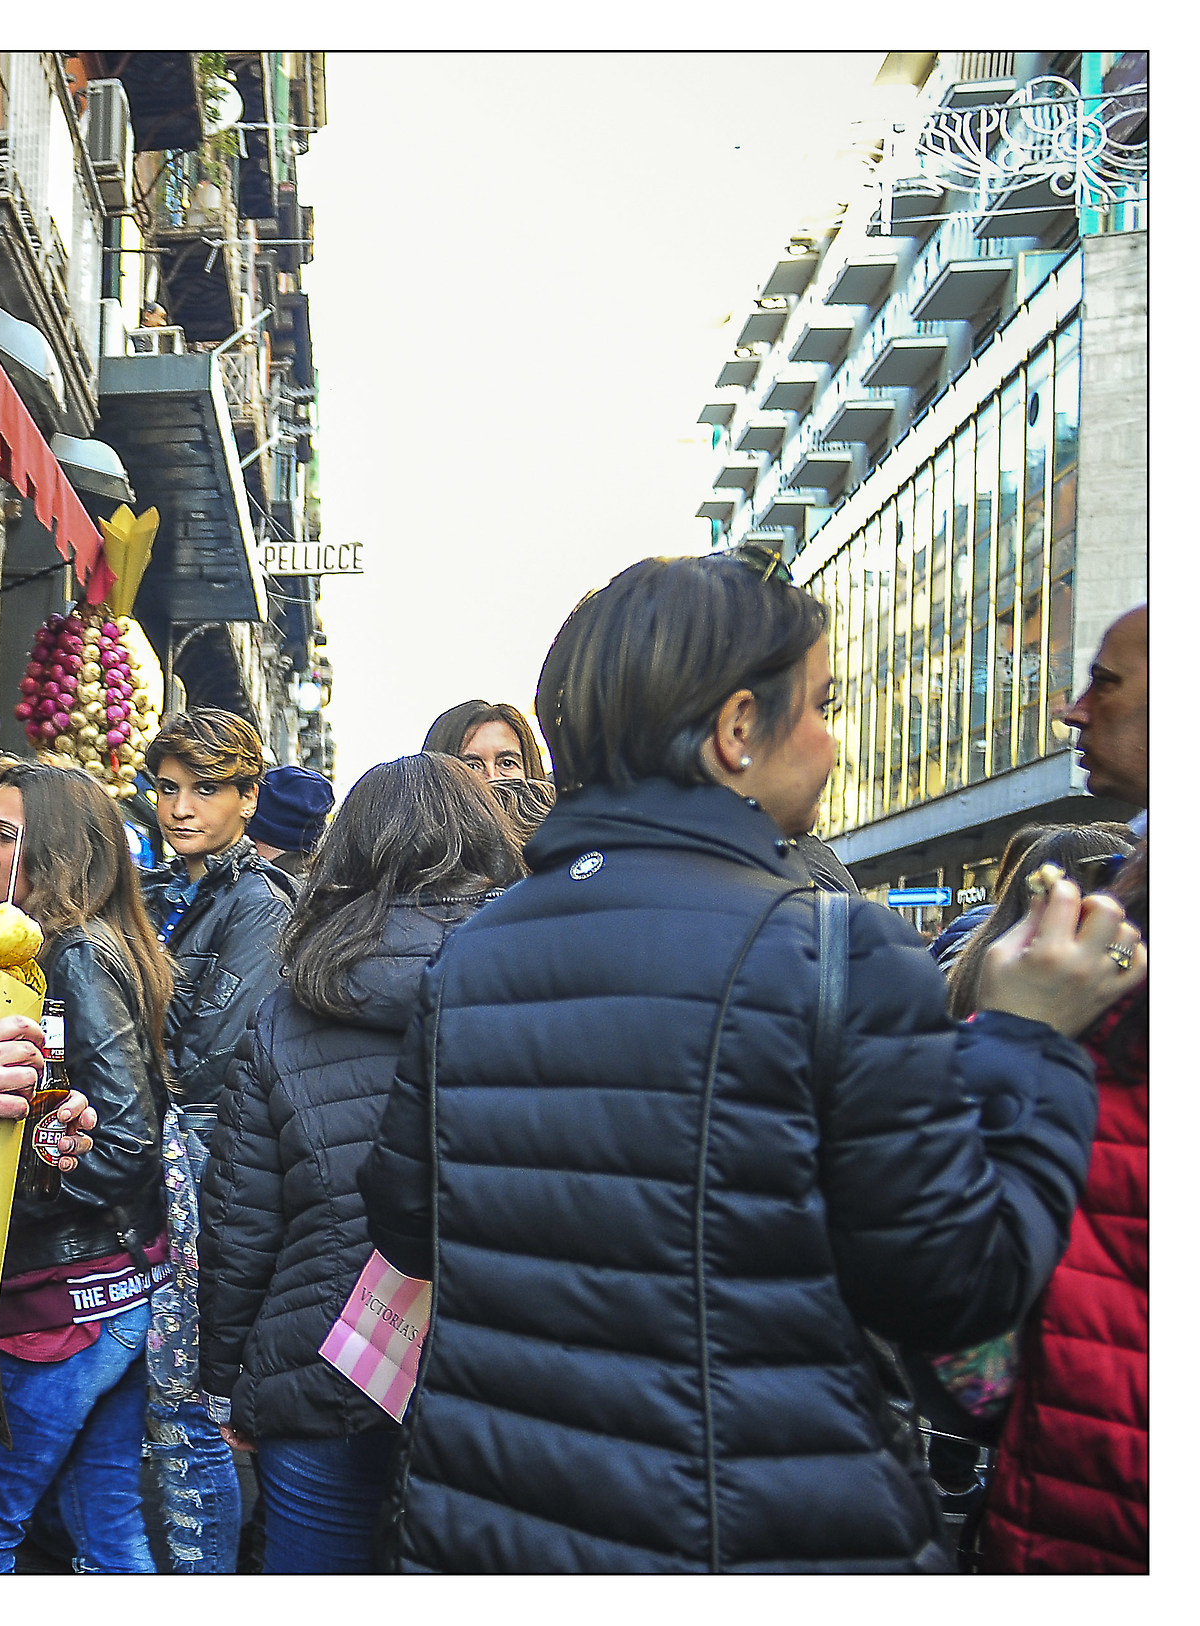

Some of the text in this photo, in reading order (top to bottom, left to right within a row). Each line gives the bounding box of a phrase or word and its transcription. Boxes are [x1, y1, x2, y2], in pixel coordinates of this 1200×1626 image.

[264, 541, 364, 572] PELLICCE
[38, 1130, 65, 1144] PER
[69, 1286, 107, 1310] THE
[360, 1286, 419, 1342] VICTORIA'S
